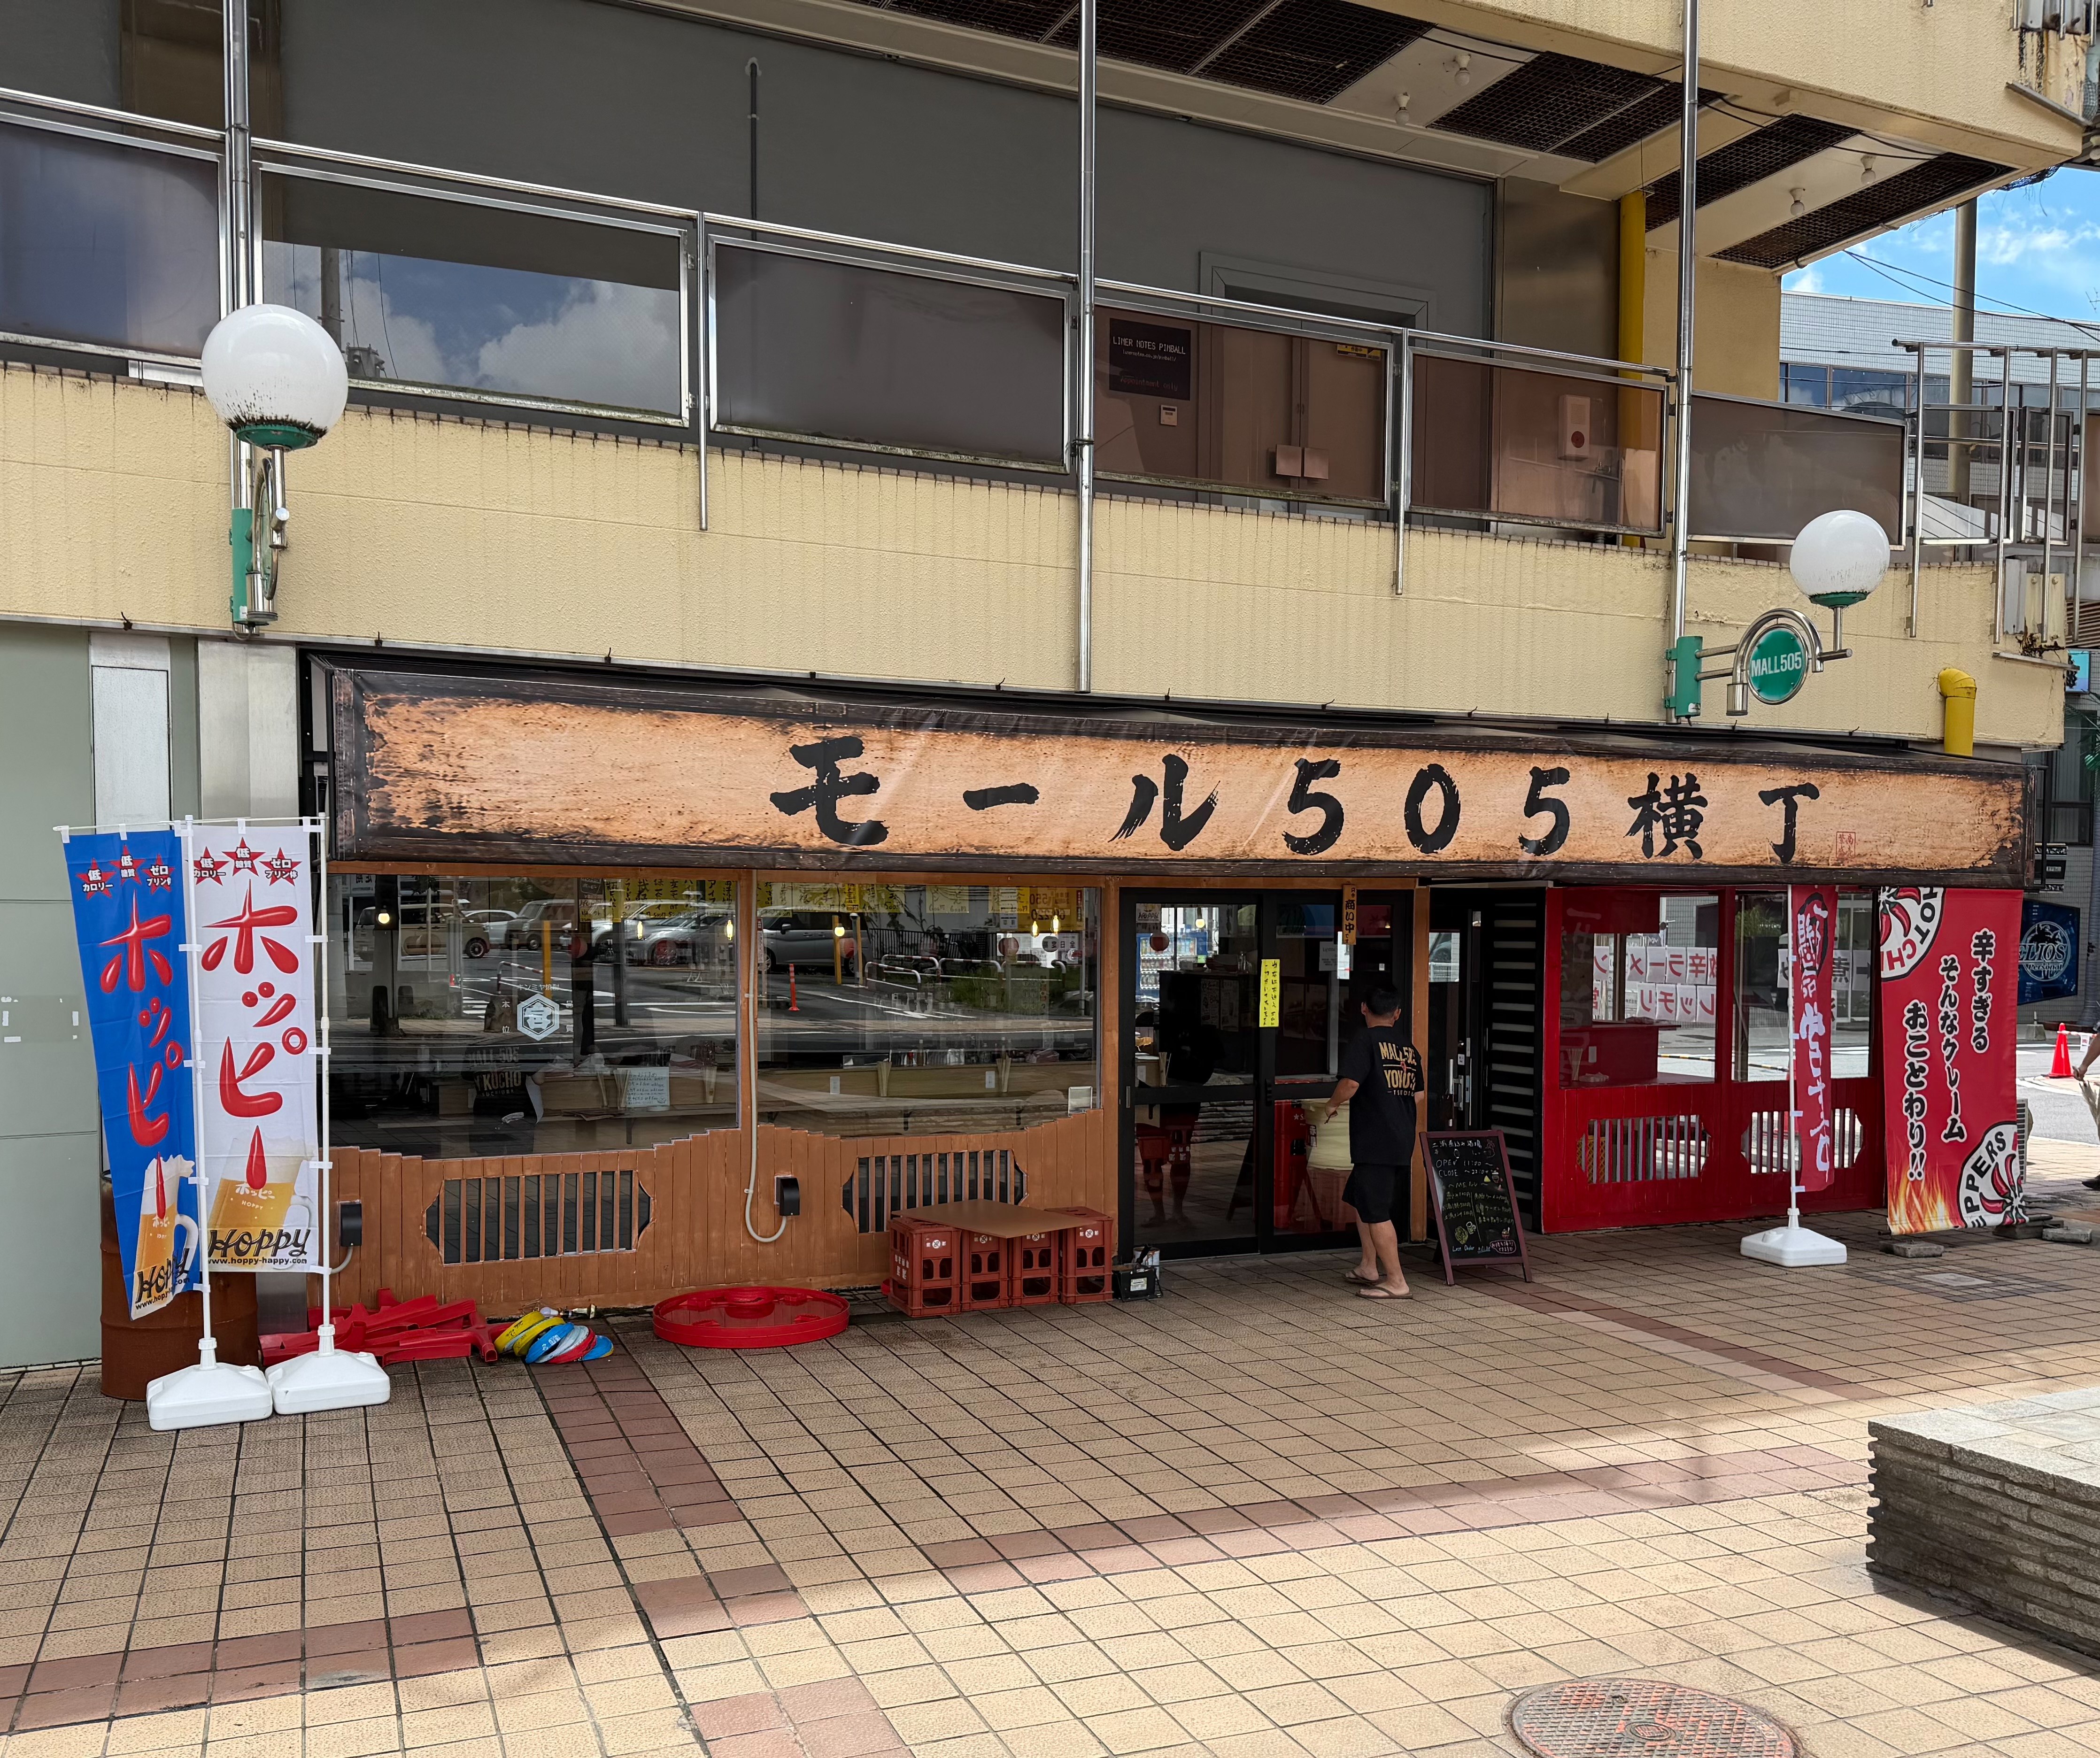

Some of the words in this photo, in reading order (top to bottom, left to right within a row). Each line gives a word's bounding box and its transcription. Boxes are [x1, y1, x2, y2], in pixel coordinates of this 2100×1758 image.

[1113, 336, 1133, 347] LINER
[1136, 339, 1156, 350] NOTES
[1159, 343, 1186, 355] PINBALL
[1751, 651, 1802, 677] MALL505
[235, 847, 251, 858] 低
[121, 855, 133, 867] 低
[200, 857, 214, 868] 低
[271, 858, 292, 869] ゼロ
[87, 869, 102, 881] 低
[150, 865, 169, 876] ゼロ
[265, 870, 298, 879] プリン体
[82, 883, 114, 892] カロリー
[1973, 929, 1995, 1052] 辛すぎる
[1939, 955, 1966, 1142] そんなクレーム
[1439, 1169, 1458, 1178] CLOSE
[241, 1200, 263, 1210] HOPPY
